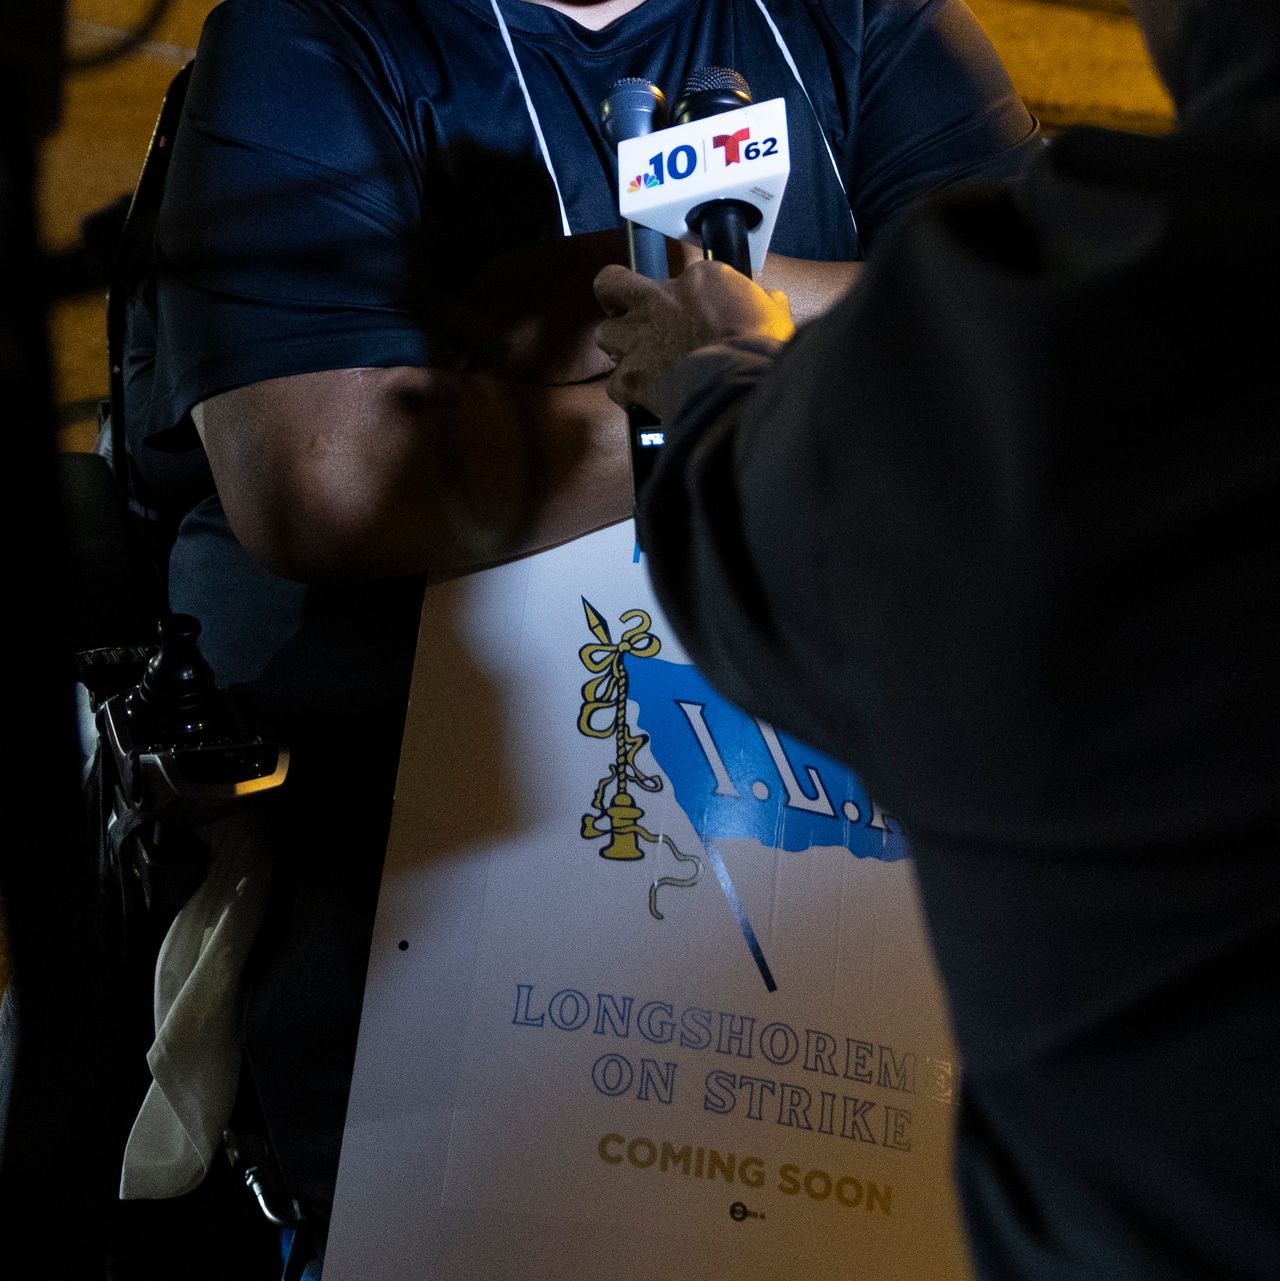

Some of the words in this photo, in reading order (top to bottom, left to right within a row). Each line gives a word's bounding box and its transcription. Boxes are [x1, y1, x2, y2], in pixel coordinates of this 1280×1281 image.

[649, 144, 697, 185] 10
[744, 137, 778, 160] 62
[592, 1053, 677, 1104] ON
[704, 1071, 912, 1152] STRIKE
[597, 1132, 766, 1189] COMING
[777, 1163, 893, 1216] SOON
